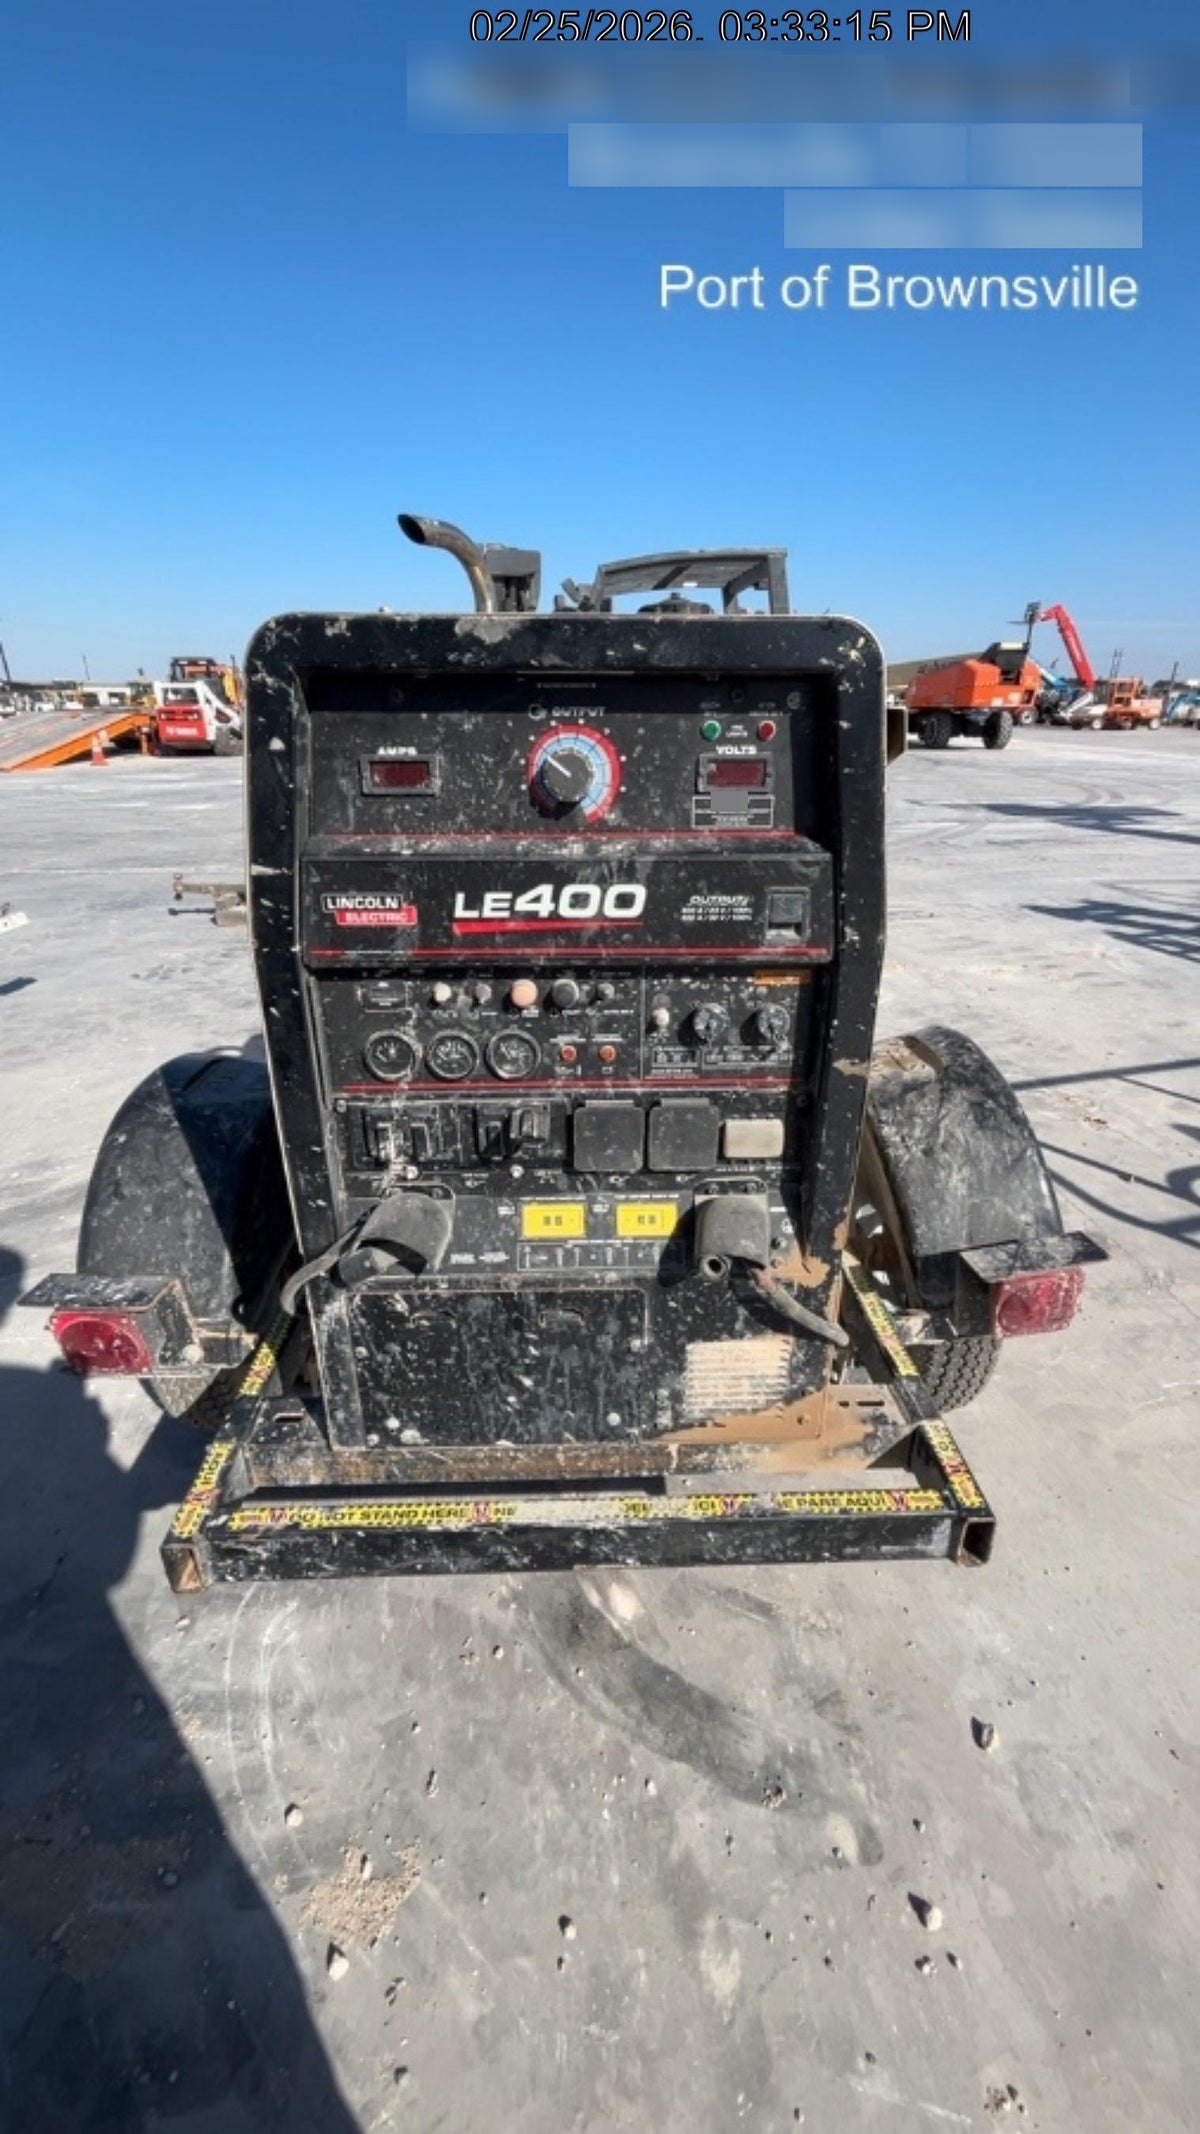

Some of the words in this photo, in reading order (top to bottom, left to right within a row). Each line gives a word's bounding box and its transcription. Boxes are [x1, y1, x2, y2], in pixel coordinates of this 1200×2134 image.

[377, 746, 418, 756] AMPS
[715, 744, 757, 755] VOLTS
[326, 896, 399, 909] LINCOLN
[453, 884, 646, 918] LE400
[345, 911, 408, 923] ELECTRIC
[360, 1510, 418, 1521] STAND
